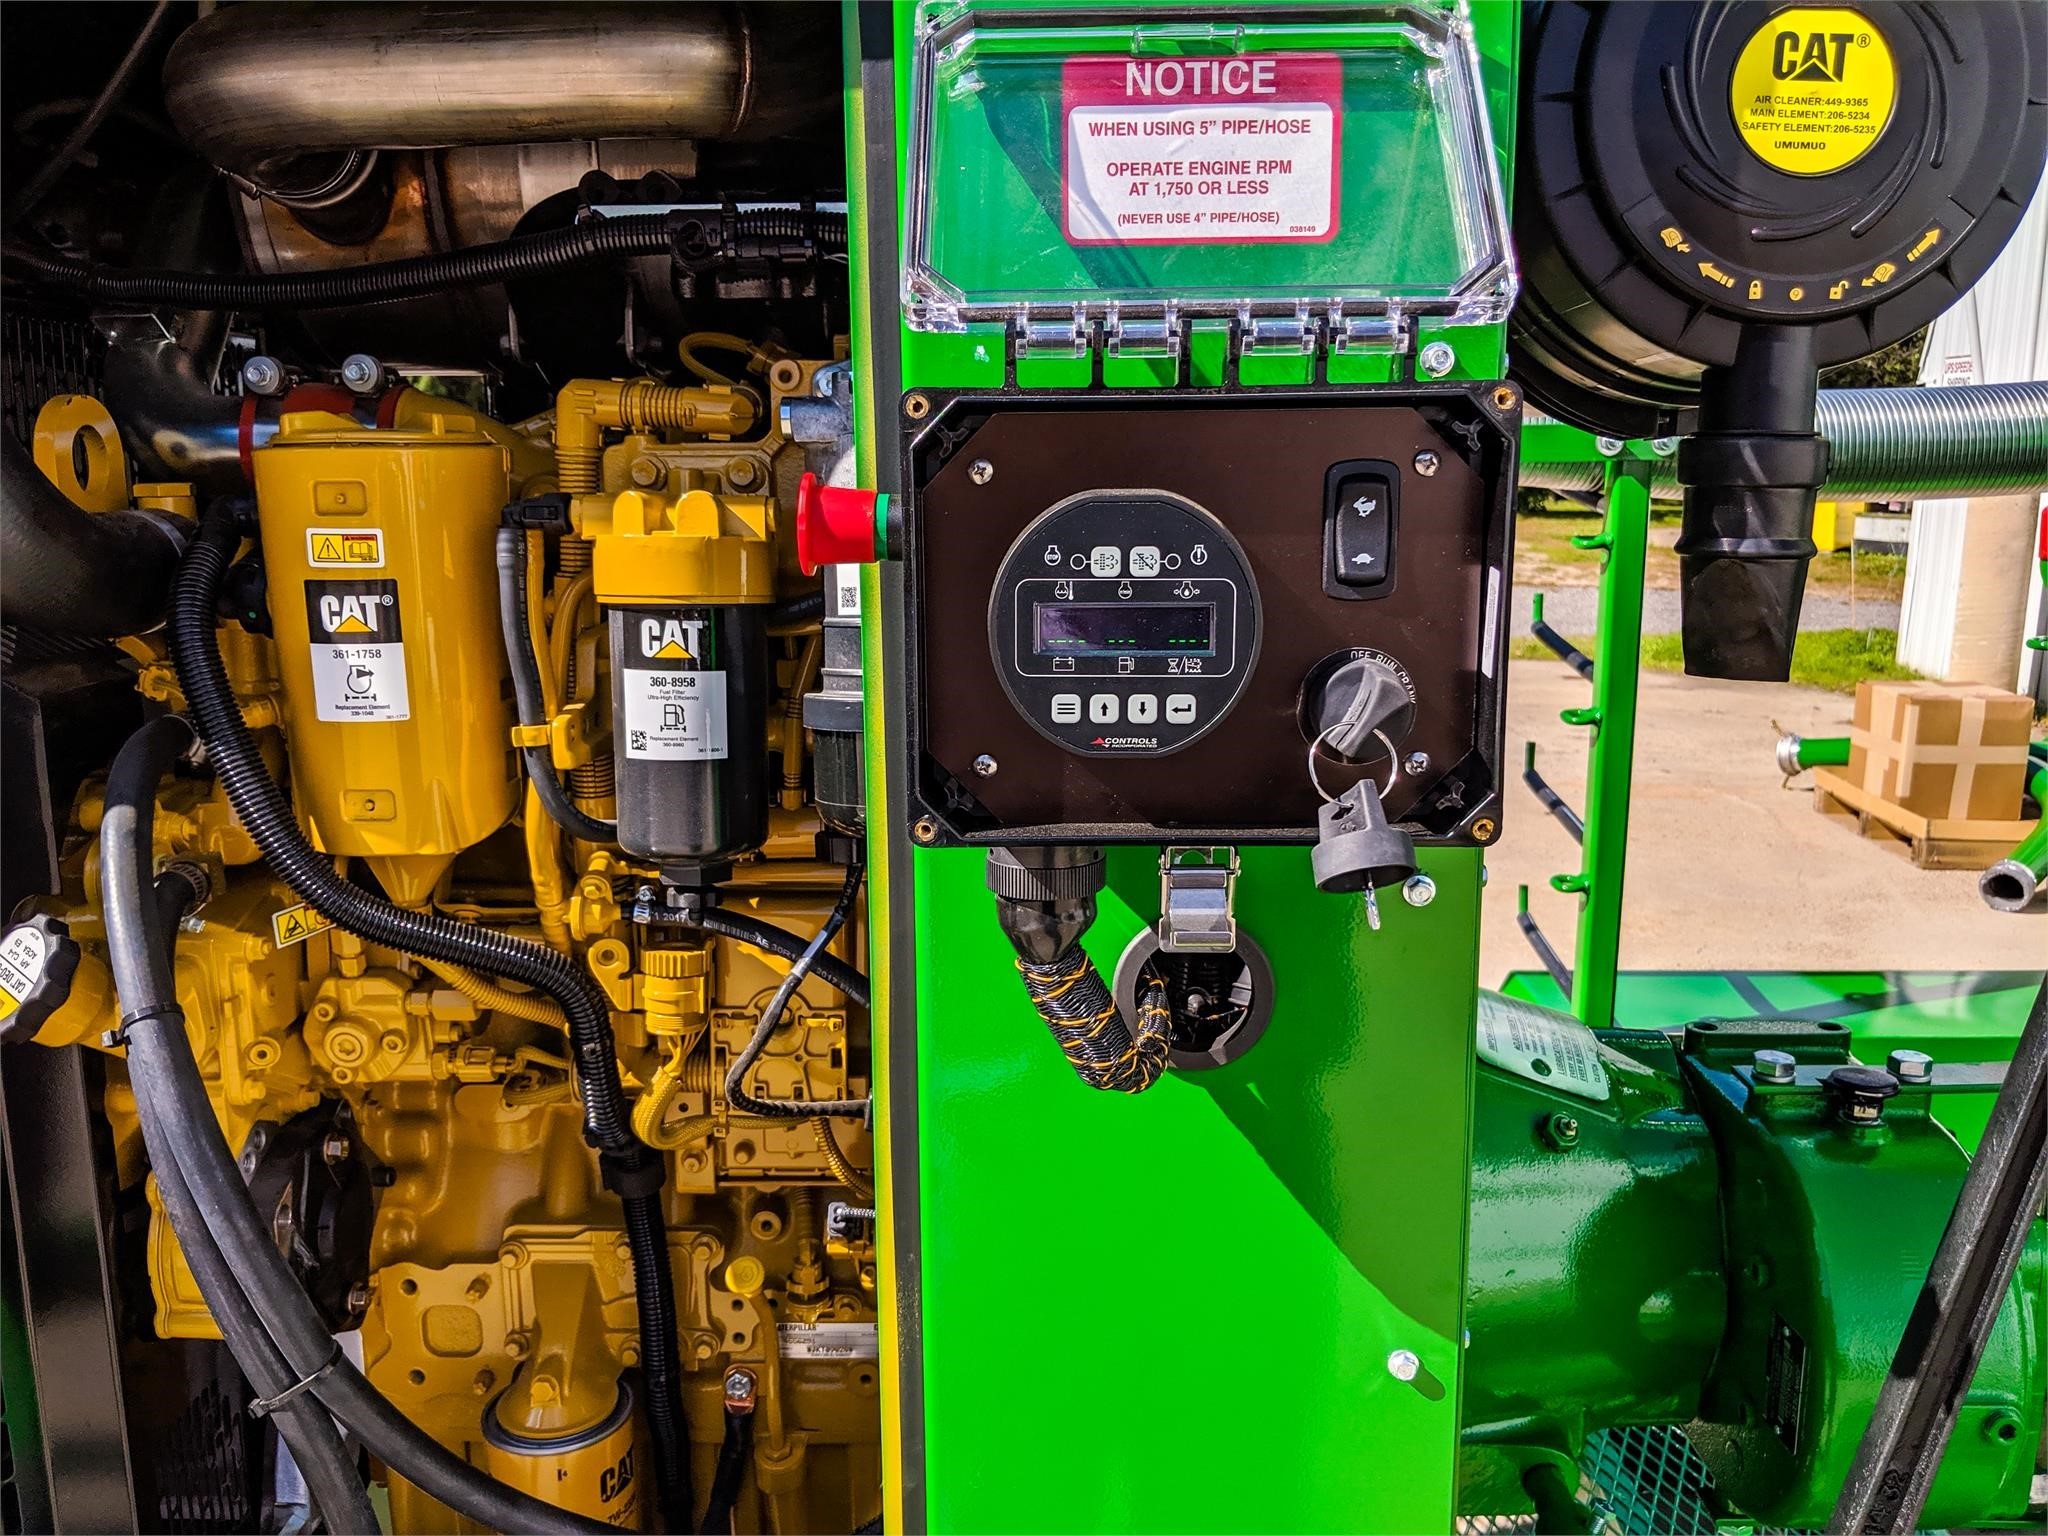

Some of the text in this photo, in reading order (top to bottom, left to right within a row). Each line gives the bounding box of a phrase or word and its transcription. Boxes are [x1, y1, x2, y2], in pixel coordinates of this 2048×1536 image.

[1126, 60, 1276, 96] NOTICE
[1754, 95, 1868, 107] AIR CLEANER:449-9365
[1750, 108, 1870, 120] MAIN ELEMENT:206-5234
[1089, 122, 1138, 136] WHEN
[1143, 121, 1195, 136] USING
[1221, 119, 1311, 135] PIPE/HOSE
[1742, 121, 1876, 134] SAFETY ELEMENT:206-5235
[1106, 160, 1292, 177] OPERATE ENGINE RPM
[1129, 180, 1269, 199] AT 1,750 OR LESS
[1118, 213, 1161, 227] (NEVER
[1166, 213, 1190, 224] USE
[1210, 212, 1280, 225] PIPE/HOSE)
[332, 649, 382, 660] 361-1758
[649, 676, 696, 688] 360-8958
[1104, 737, 1158, 745] CONTROLS
[662, 912, 687, 922] 2017
